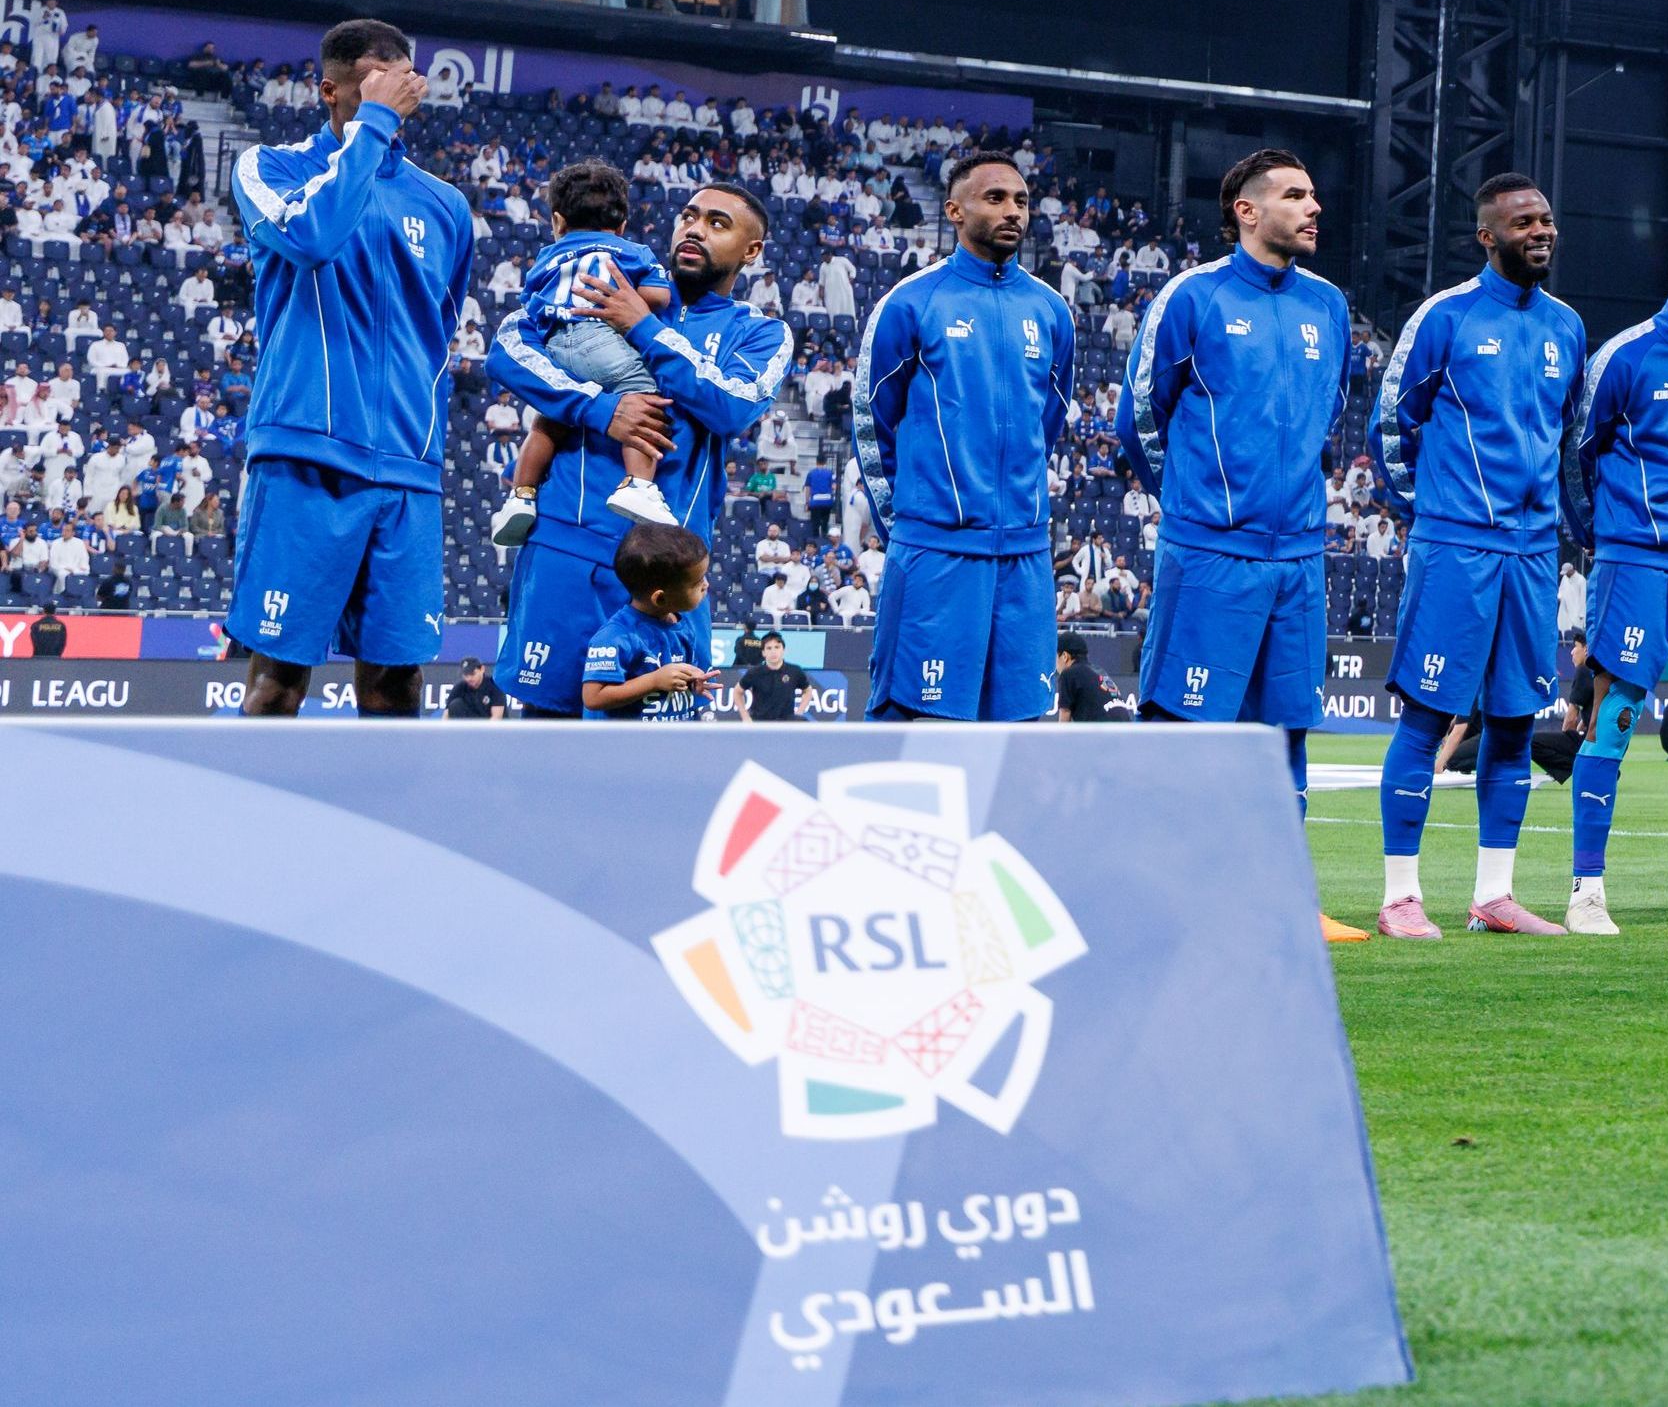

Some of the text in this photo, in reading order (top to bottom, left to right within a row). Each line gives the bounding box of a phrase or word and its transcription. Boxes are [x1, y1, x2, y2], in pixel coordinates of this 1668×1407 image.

[946, 327, 970, 338] KING
[32, 680, 130, 707] LEAGU
[1321, 695, 1376, 719] AUDI
[807, 911, 948, 976] RSL
[756, 1184, 1081, 1261] دوري روشن
[769, 1249, 1096, 1371] السعودي
